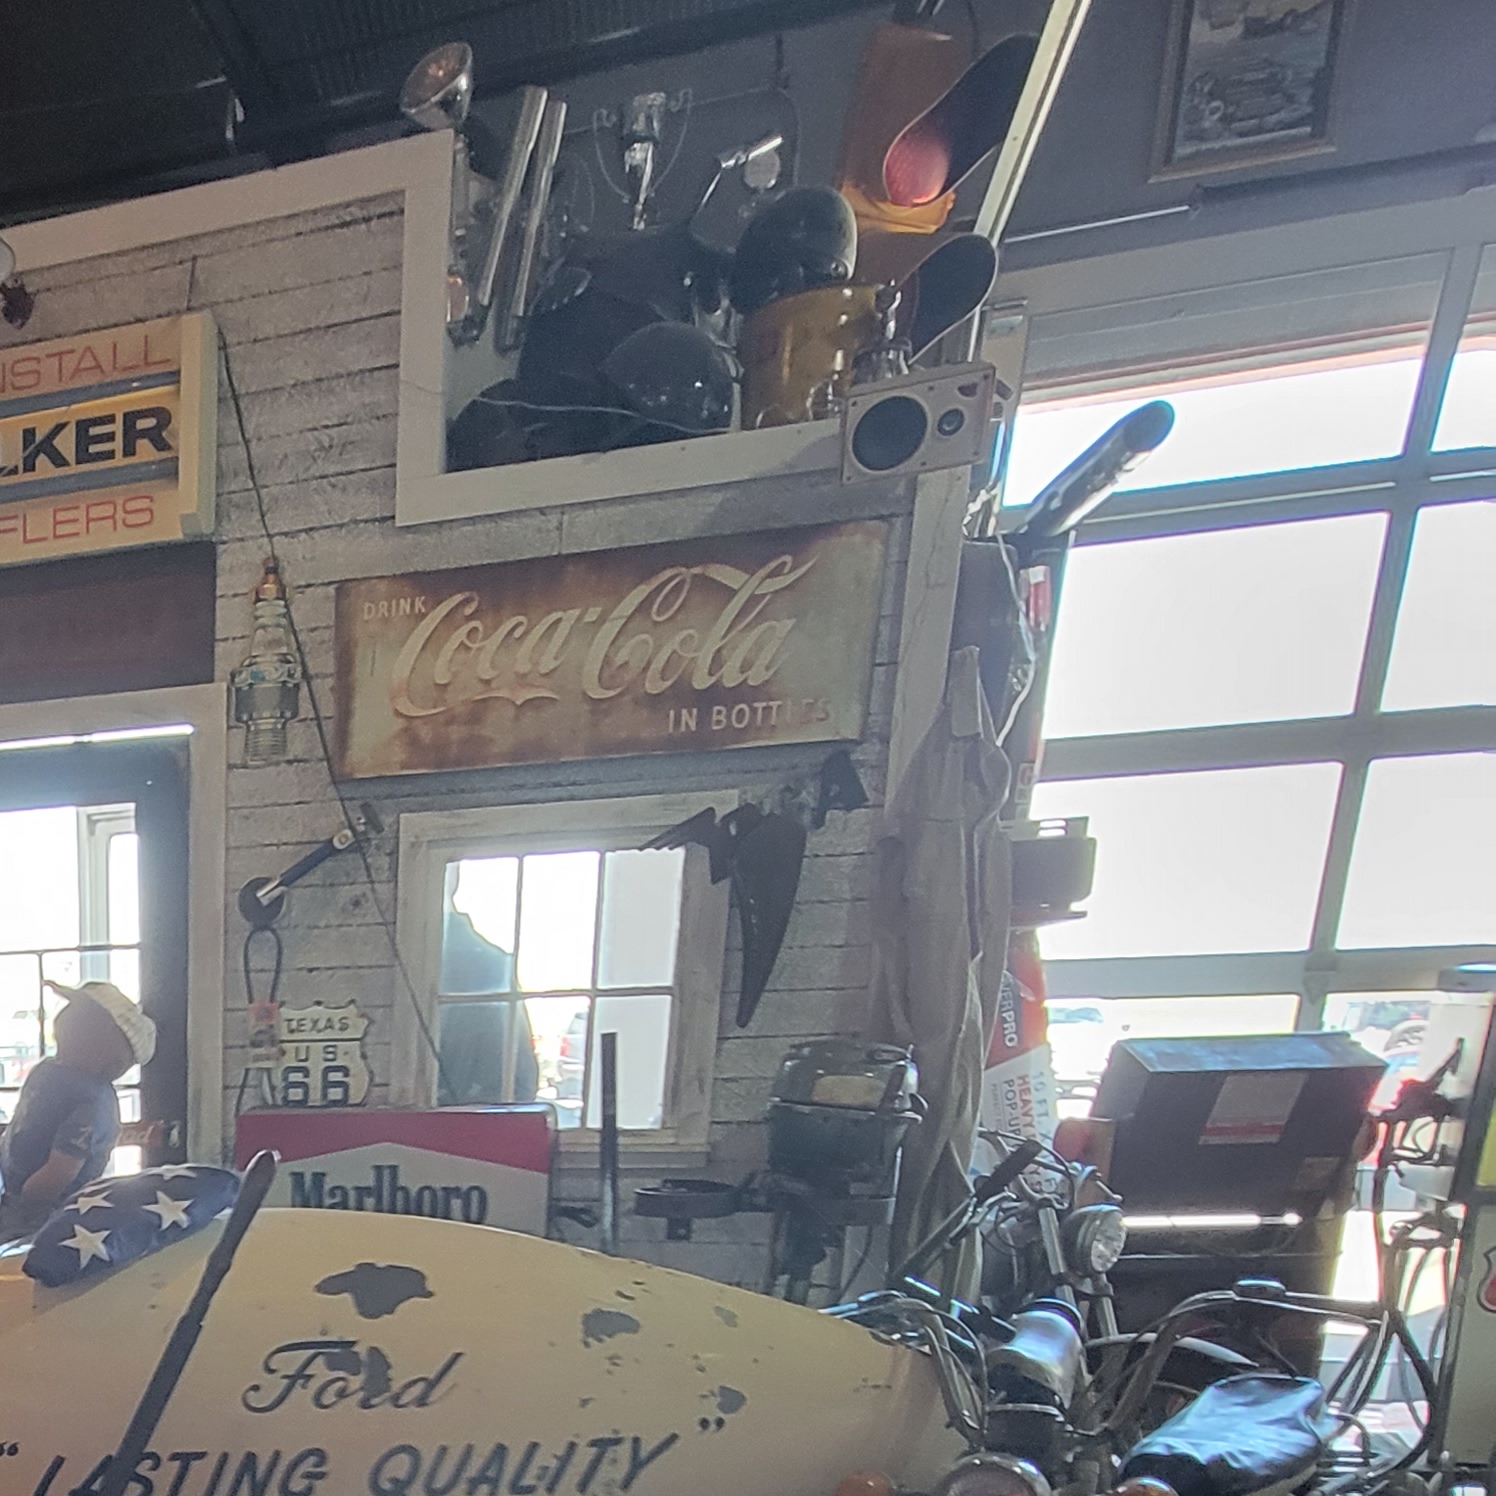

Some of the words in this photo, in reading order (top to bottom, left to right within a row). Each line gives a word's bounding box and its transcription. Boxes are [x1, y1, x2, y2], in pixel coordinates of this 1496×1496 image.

[362, 595, 428, 622] DRINK
[392, 554, 818, 718] Coca-Cola
[668, 708, 699, 734] IN
[283, 1015, 351, 1035] TEXAS
[281, 1065, 351, 1107] 66
[1002, 1078, 1022, 1136] POP-UP
[1017, 1074, 1036, 1129] HEAVY
[290, 1165, 488, 1224] Marlboro
[240, 1340, 464, 1414] Ford
